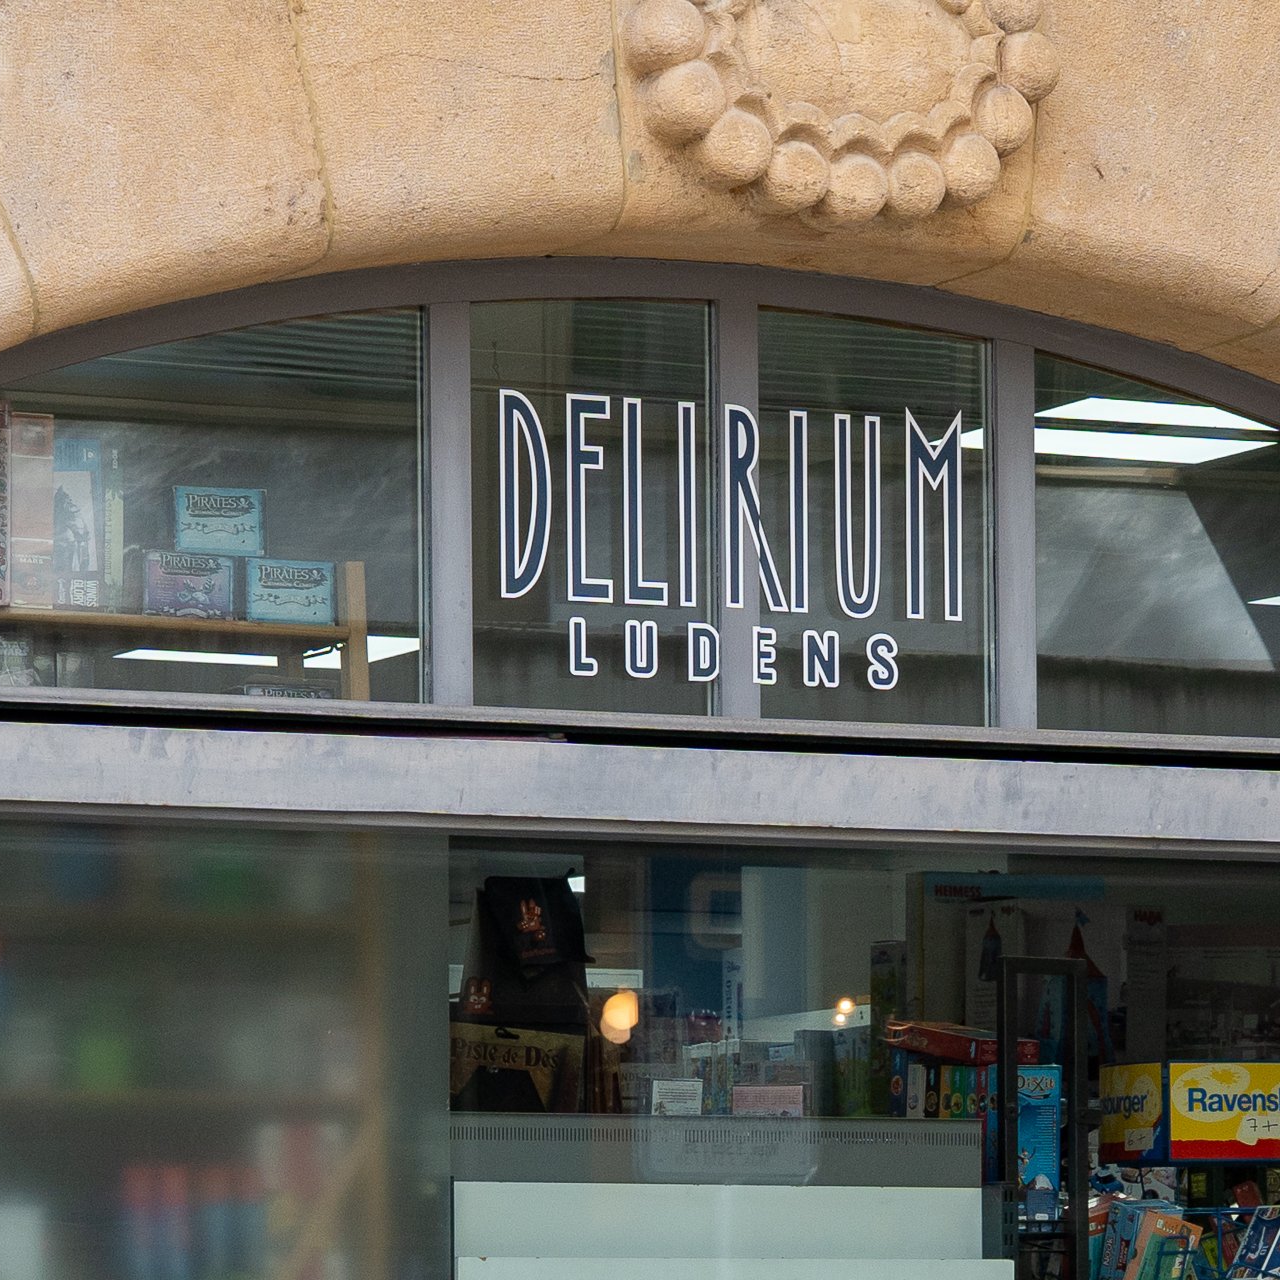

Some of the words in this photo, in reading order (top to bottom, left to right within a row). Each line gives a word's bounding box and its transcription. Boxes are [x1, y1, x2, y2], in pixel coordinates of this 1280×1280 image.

[188, 494, 237, 508] PIRATES
[499, 388, 963, 622] DELIRIUM
[160, 555, 206, 569] PIRATES
[261, 566, 310, 580] PIRATES
[72, 580, 84, 606] GLORY
[87, 580, 99, 607] WINGS
[569, 617, 899, 690] LUDENS
[502, 1046, 518, 1064] de
[1017, 1074, 1056, 1092] Dixit
[1246, 1118, 1279, 1132] 7+
